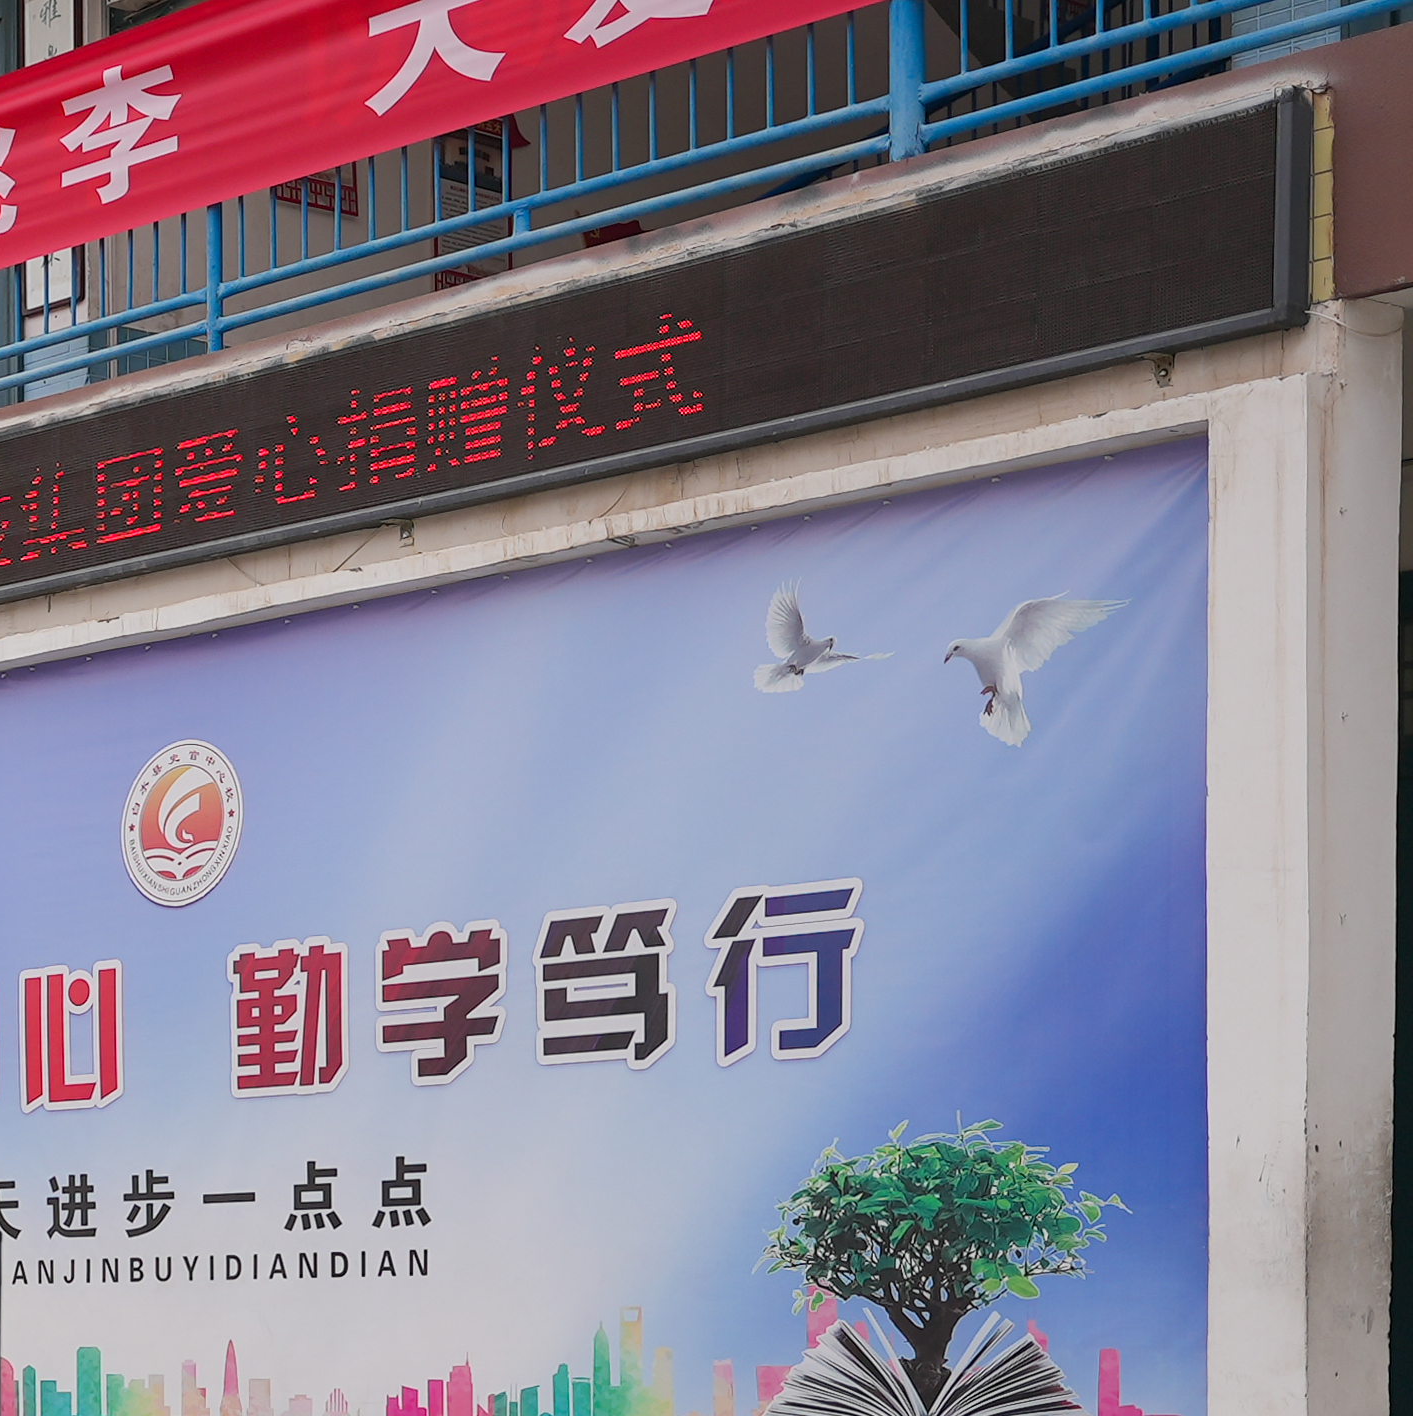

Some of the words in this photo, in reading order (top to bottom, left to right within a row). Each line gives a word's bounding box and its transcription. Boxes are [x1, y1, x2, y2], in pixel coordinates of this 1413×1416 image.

[230, 885, 862, 1091] 勤学笃行
[11, 1248, 430, 1286] ANJINBUYIDIANDIAN
